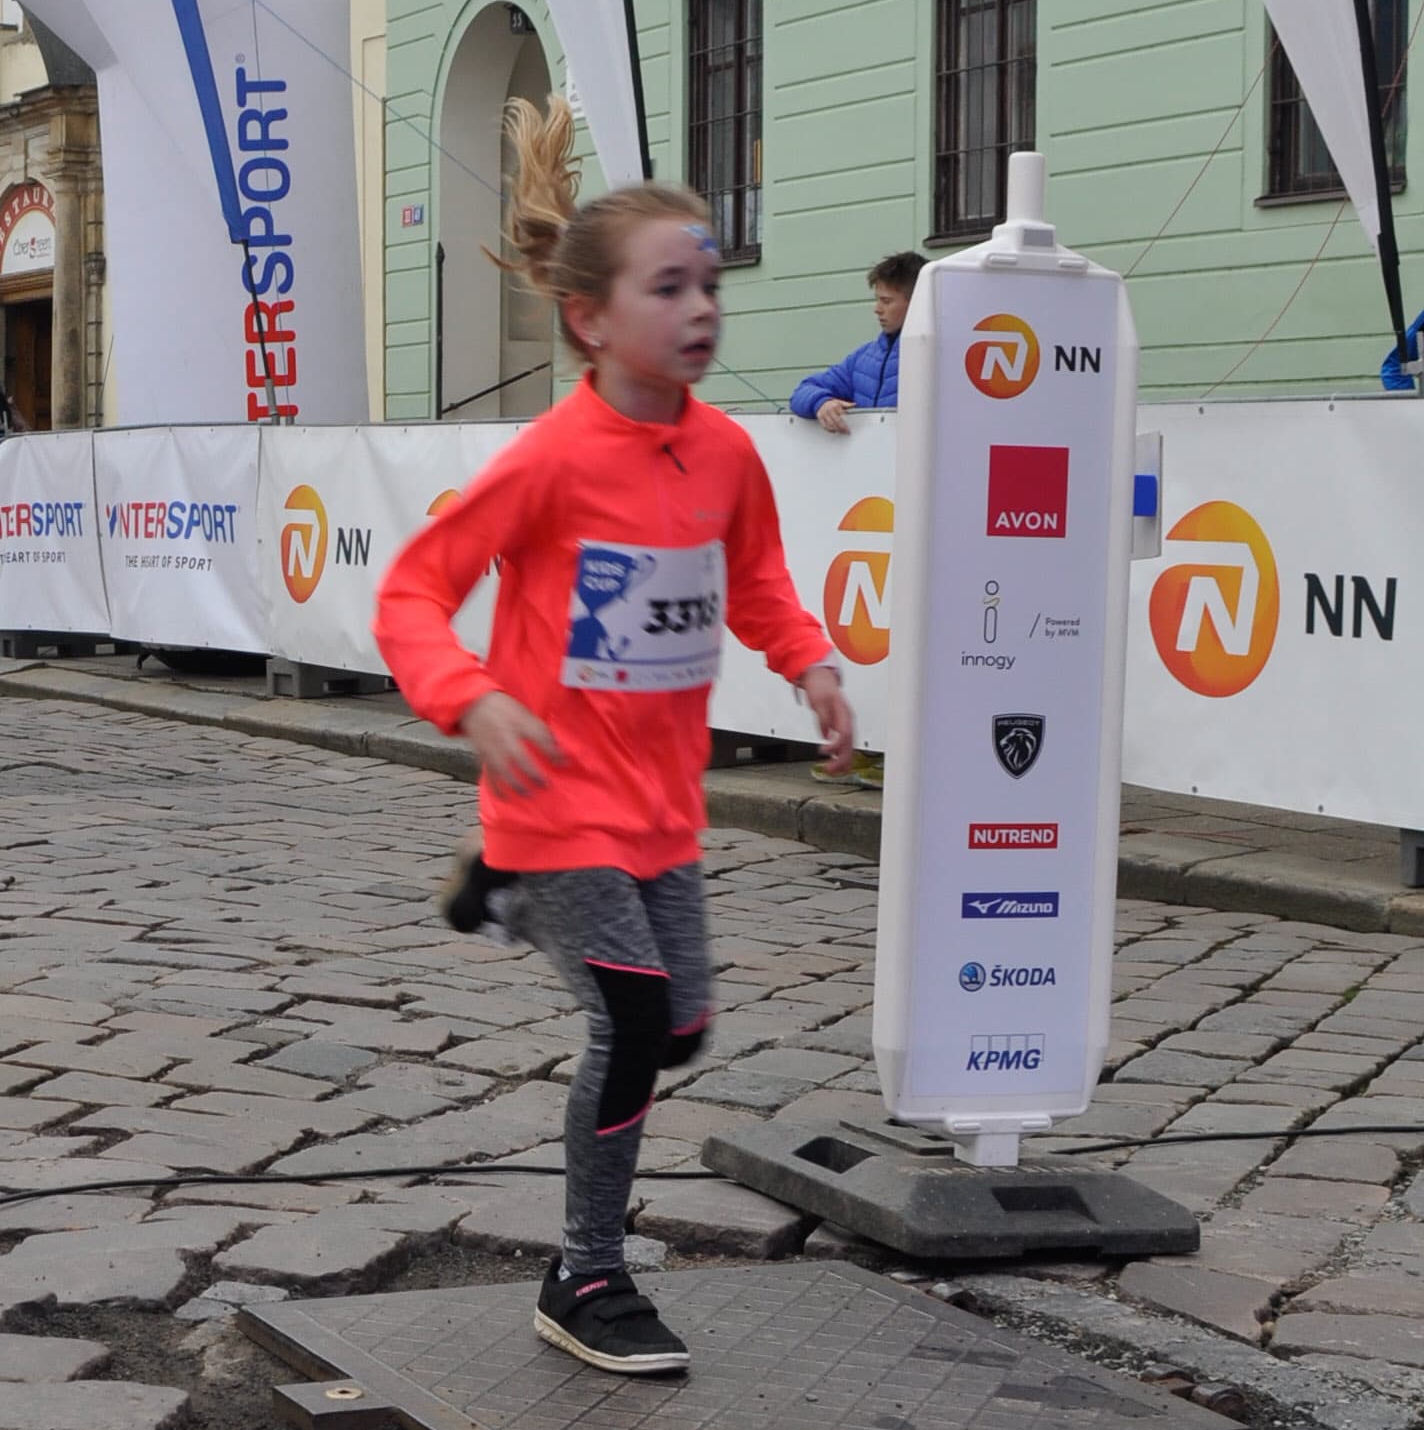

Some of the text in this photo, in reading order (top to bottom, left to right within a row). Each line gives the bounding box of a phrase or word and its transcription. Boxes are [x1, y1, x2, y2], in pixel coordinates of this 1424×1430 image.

[1054, 345, 1102, 374] NN
[994, 511, 1059, 531] AVON
[336, 527, 372, 567] NN
[175, 555, 213, 572] SPORT
[1303, 572, 1399, 642] NN
[961, 651, 1017, 670] innogy
[973, 828, 1055, 844] NUTREND
[989, 964, 1056, 987] ŠKODA
[965, 1048, 1041, 1071] KPMG
